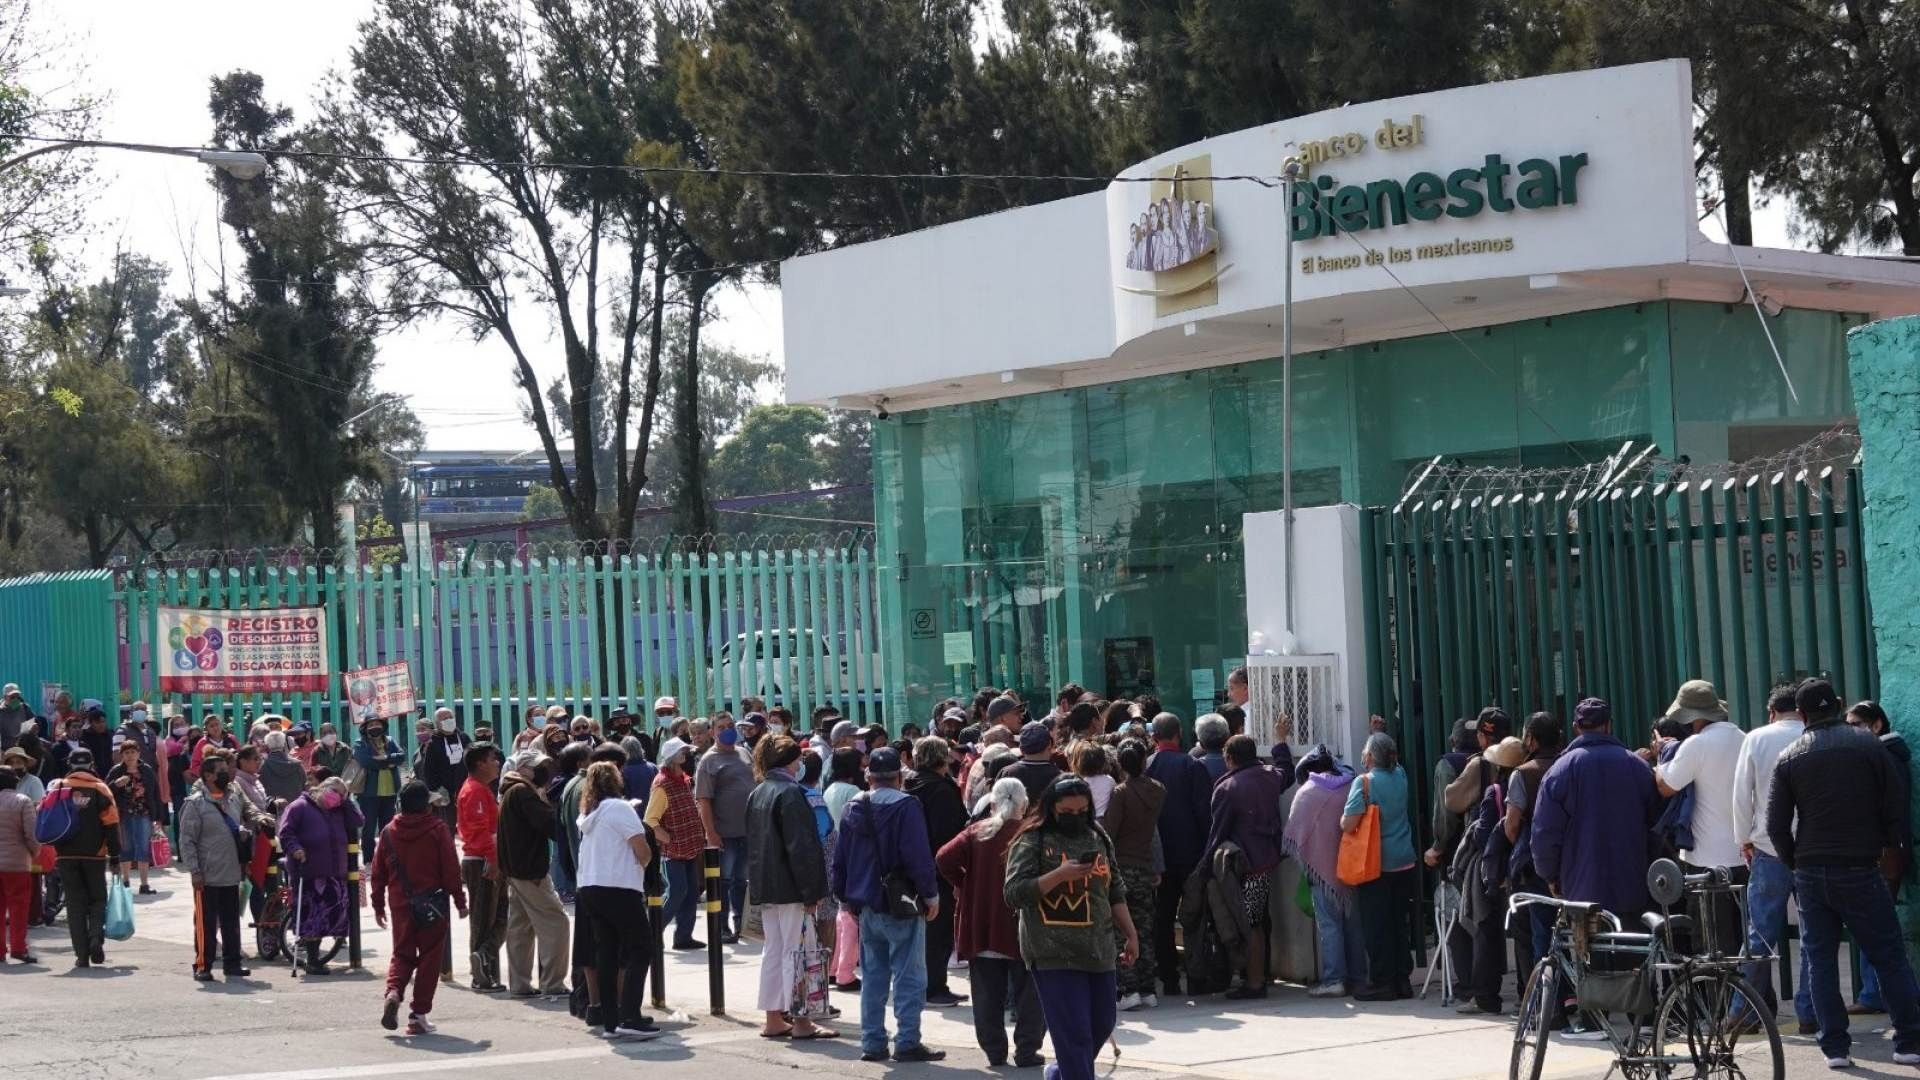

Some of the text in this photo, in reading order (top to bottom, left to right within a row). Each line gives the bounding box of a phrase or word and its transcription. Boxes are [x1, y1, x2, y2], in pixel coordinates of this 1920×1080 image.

[1291, 114, 1421, 166] anco del
[1287, 152, 1588, 241] Bienestar
[1302, 237, 1514, 273] El banco de los mexicanos
[227, 616, 318, 631] REGISTRO
[231, 633, 318, 643] DE SOLICITANTES
[229, 660, 320, 671] DISCAPACIDAD
